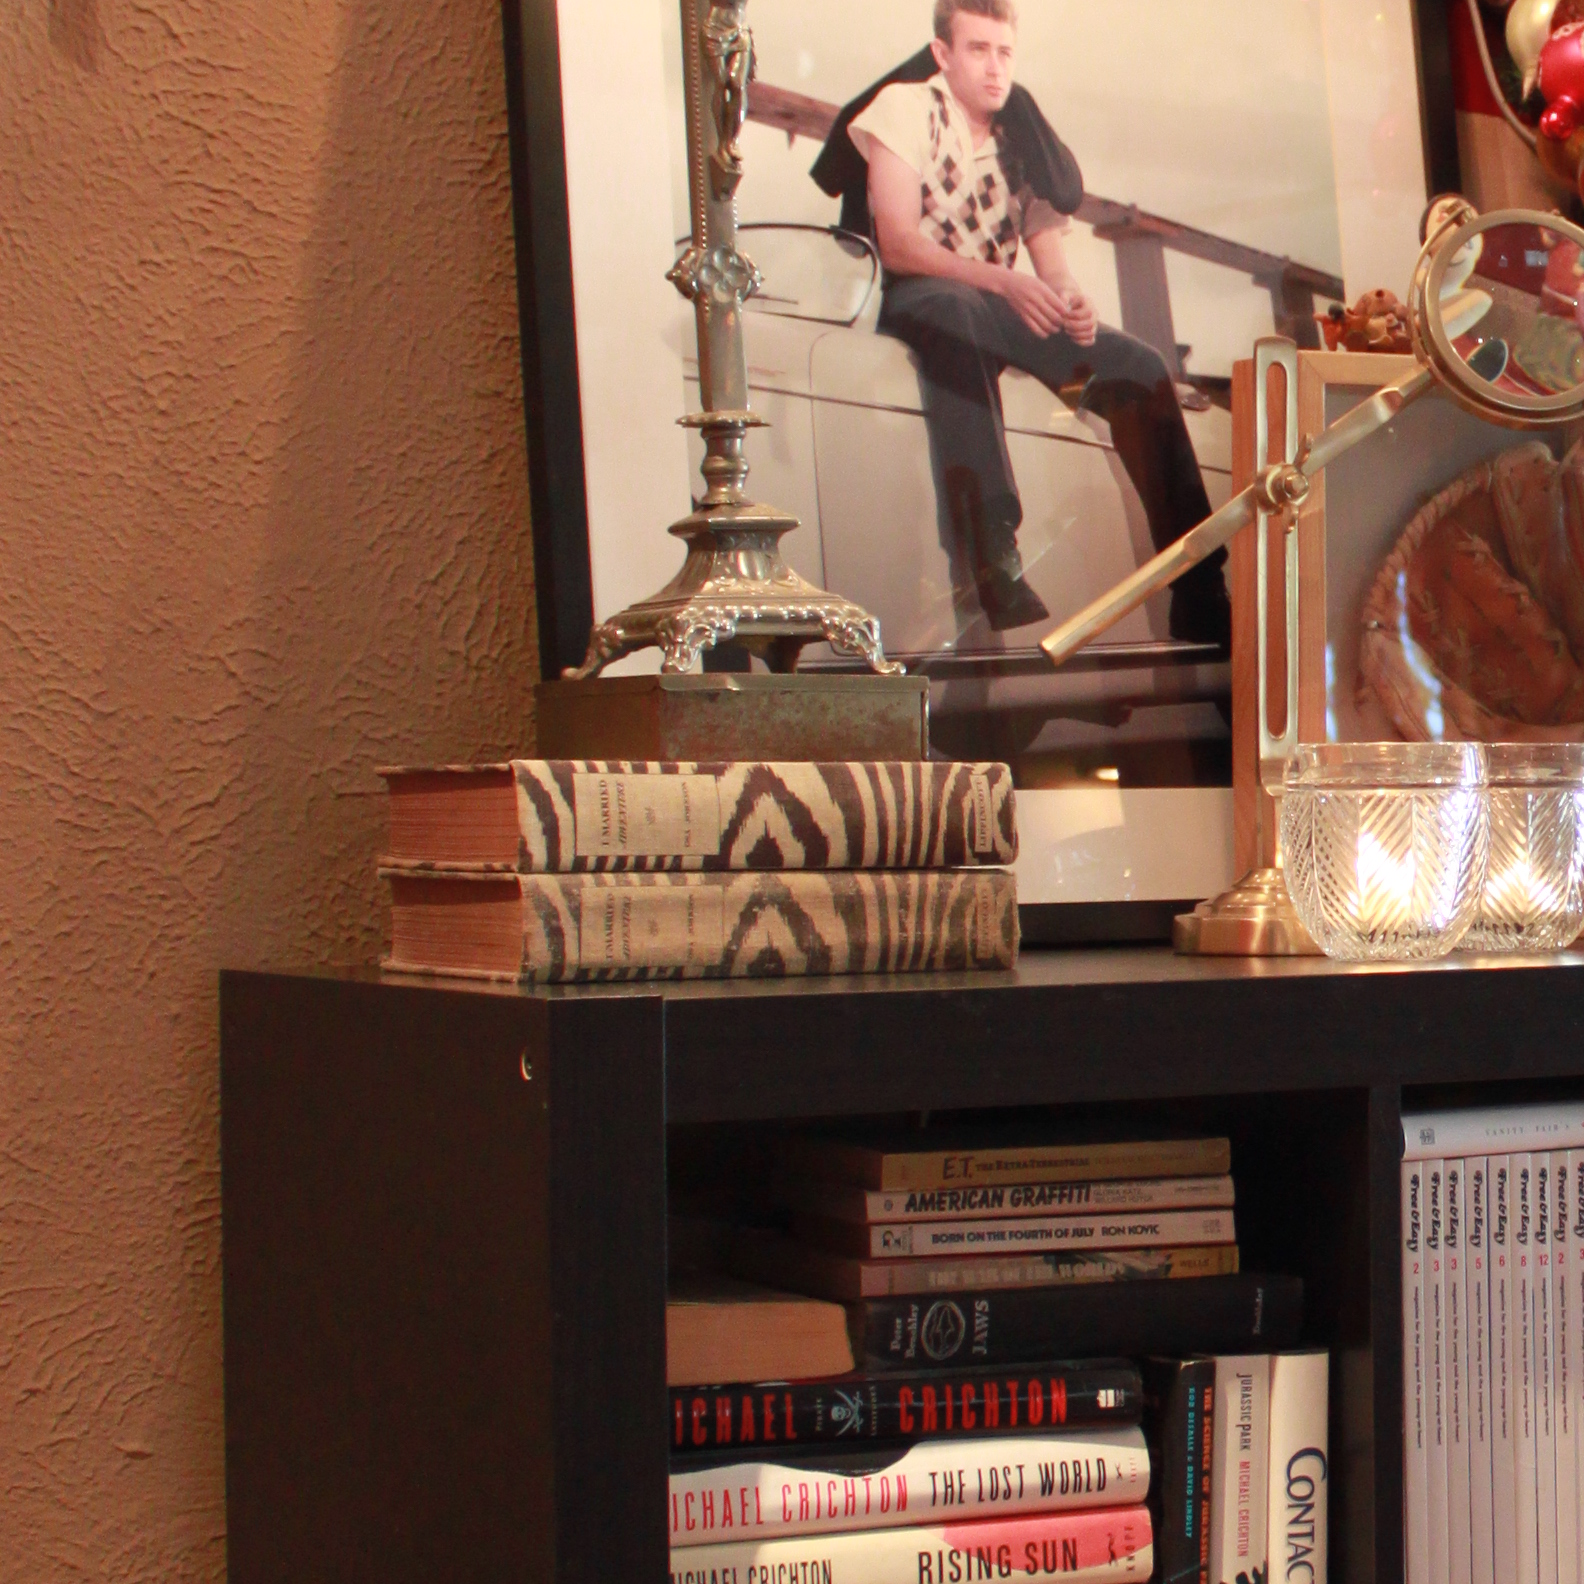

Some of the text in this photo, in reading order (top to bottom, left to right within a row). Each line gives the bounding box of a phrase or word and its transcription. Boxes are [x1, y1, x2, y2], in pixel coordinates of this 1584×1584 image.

[905, 1187, 1005, 1213] AMERICAN
[1010, 1183, 1090, 1207] GRAFFITI
[932, 1226, 1094, 1245] BORN ON THE FOURTH OF JULY
[675, 1392, 797, 1446] ICHAEL
[899, 1378, 1067, 1433] CRICHTON
[1237, 1373, 1252, 1557] JURASSIC PARK MICHAEL CRICHTON
[672, 1458, 1107, 1532] ICHAEL CRICHTON THE LOST WORLD
[1025, 1537, 1078, 1575] SUN
